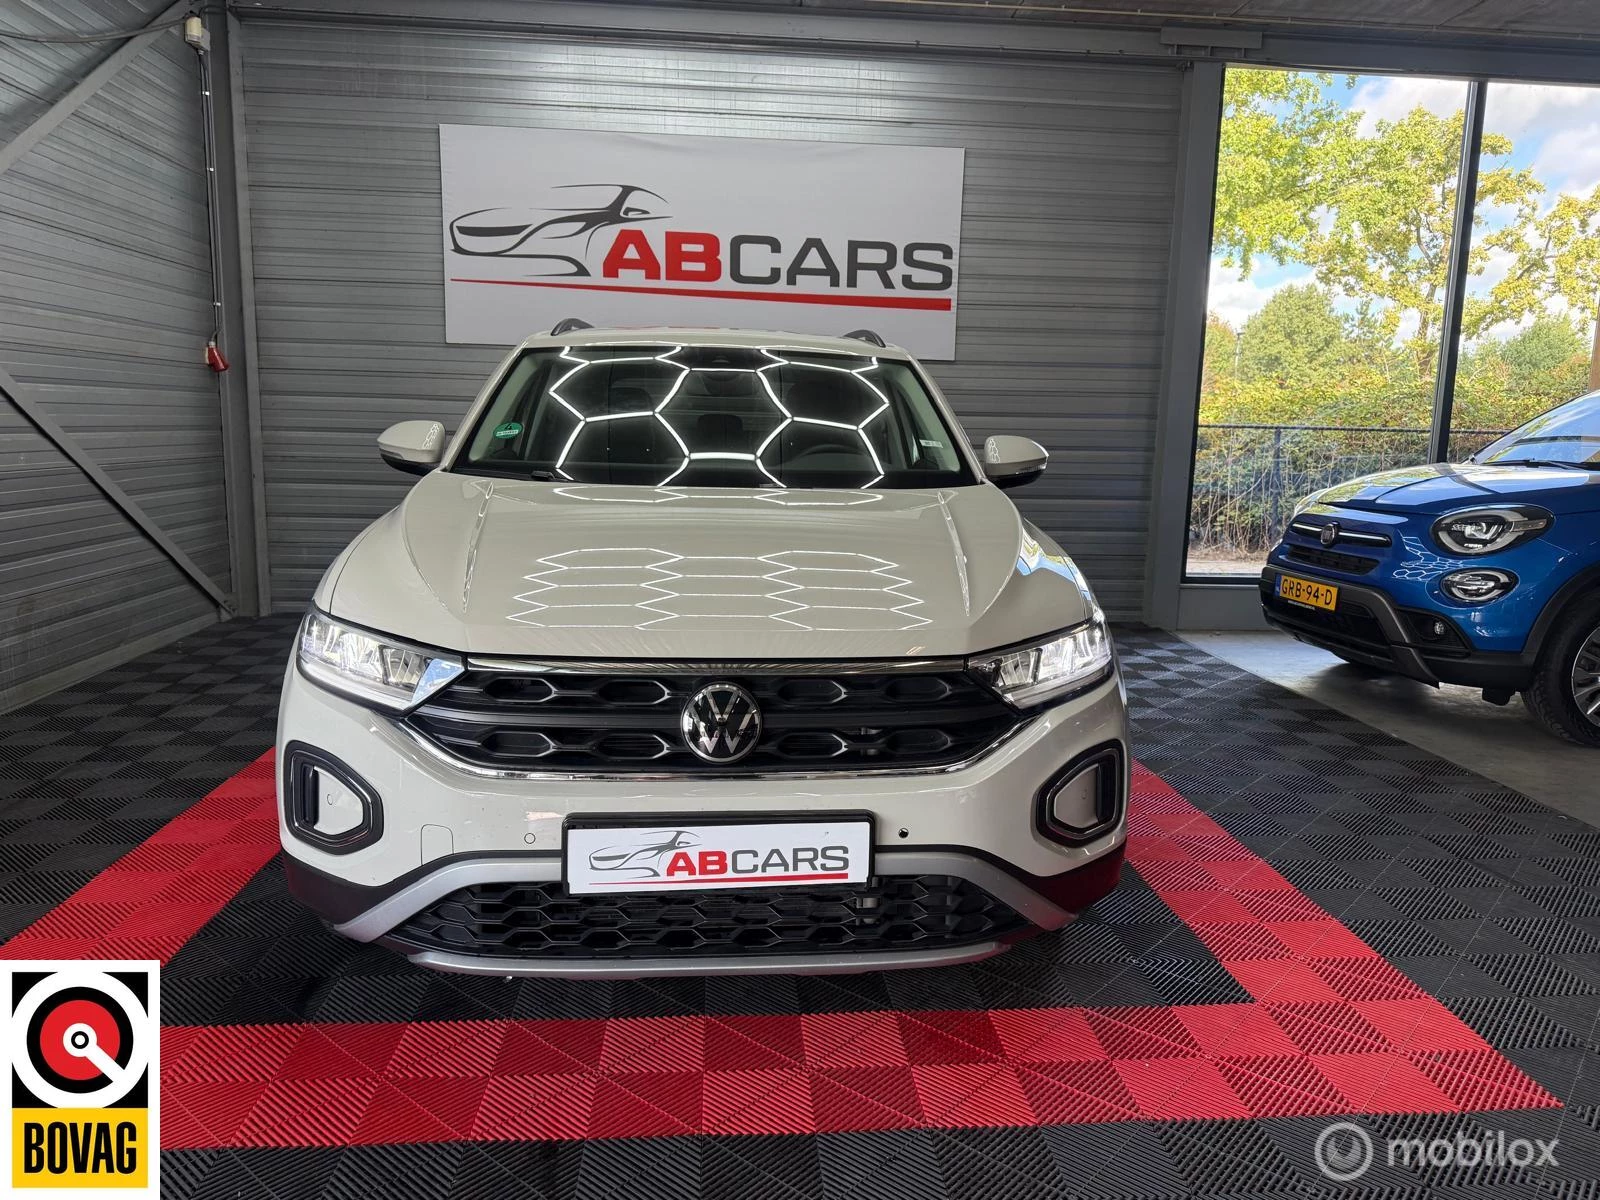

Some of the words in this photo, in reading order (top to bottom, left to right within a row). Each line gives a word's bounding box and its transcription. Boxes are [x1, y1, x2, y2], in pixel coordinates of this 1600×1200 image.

[602, 229, 953, 291] ABCARS
[1281, 578, 1333, 606] GRB-94-D
[666, 845, 850, 877] ABCARS
